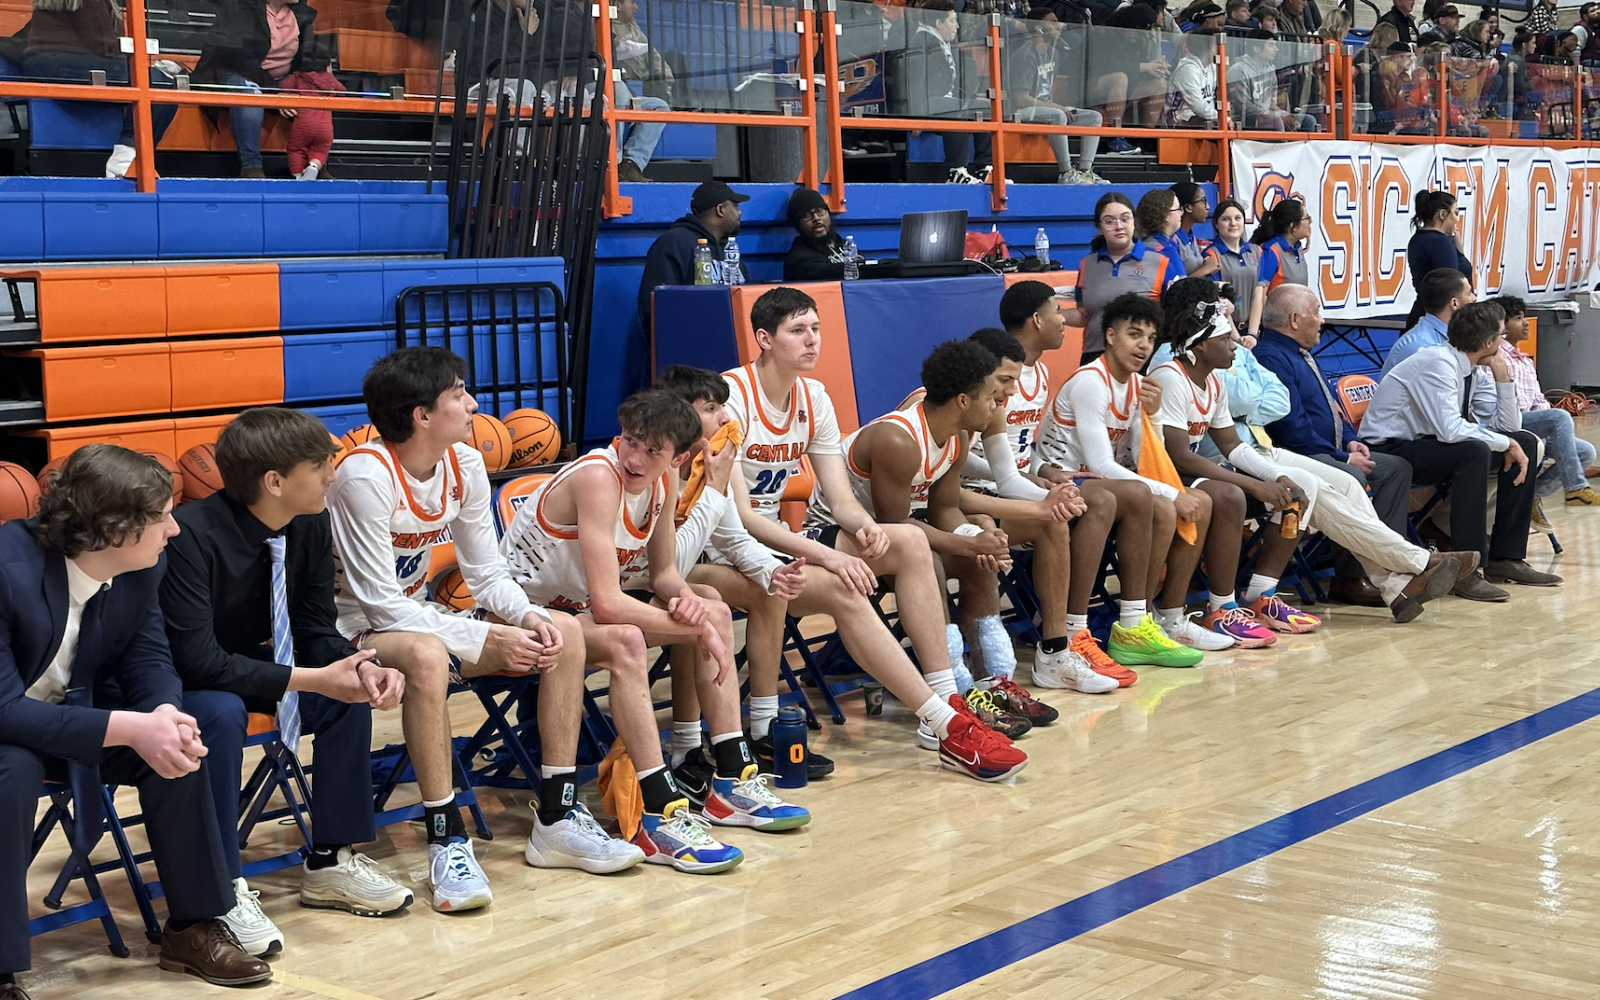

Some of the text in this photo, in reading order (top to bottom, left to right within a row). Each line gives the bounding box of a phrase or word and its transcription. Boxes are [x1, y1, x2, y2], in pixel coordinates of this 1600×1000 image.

[1318, 155, 1411, 309] SIC
[1525, 159, 1600, 293] CAT
[749, 469, 787, 495] 20
